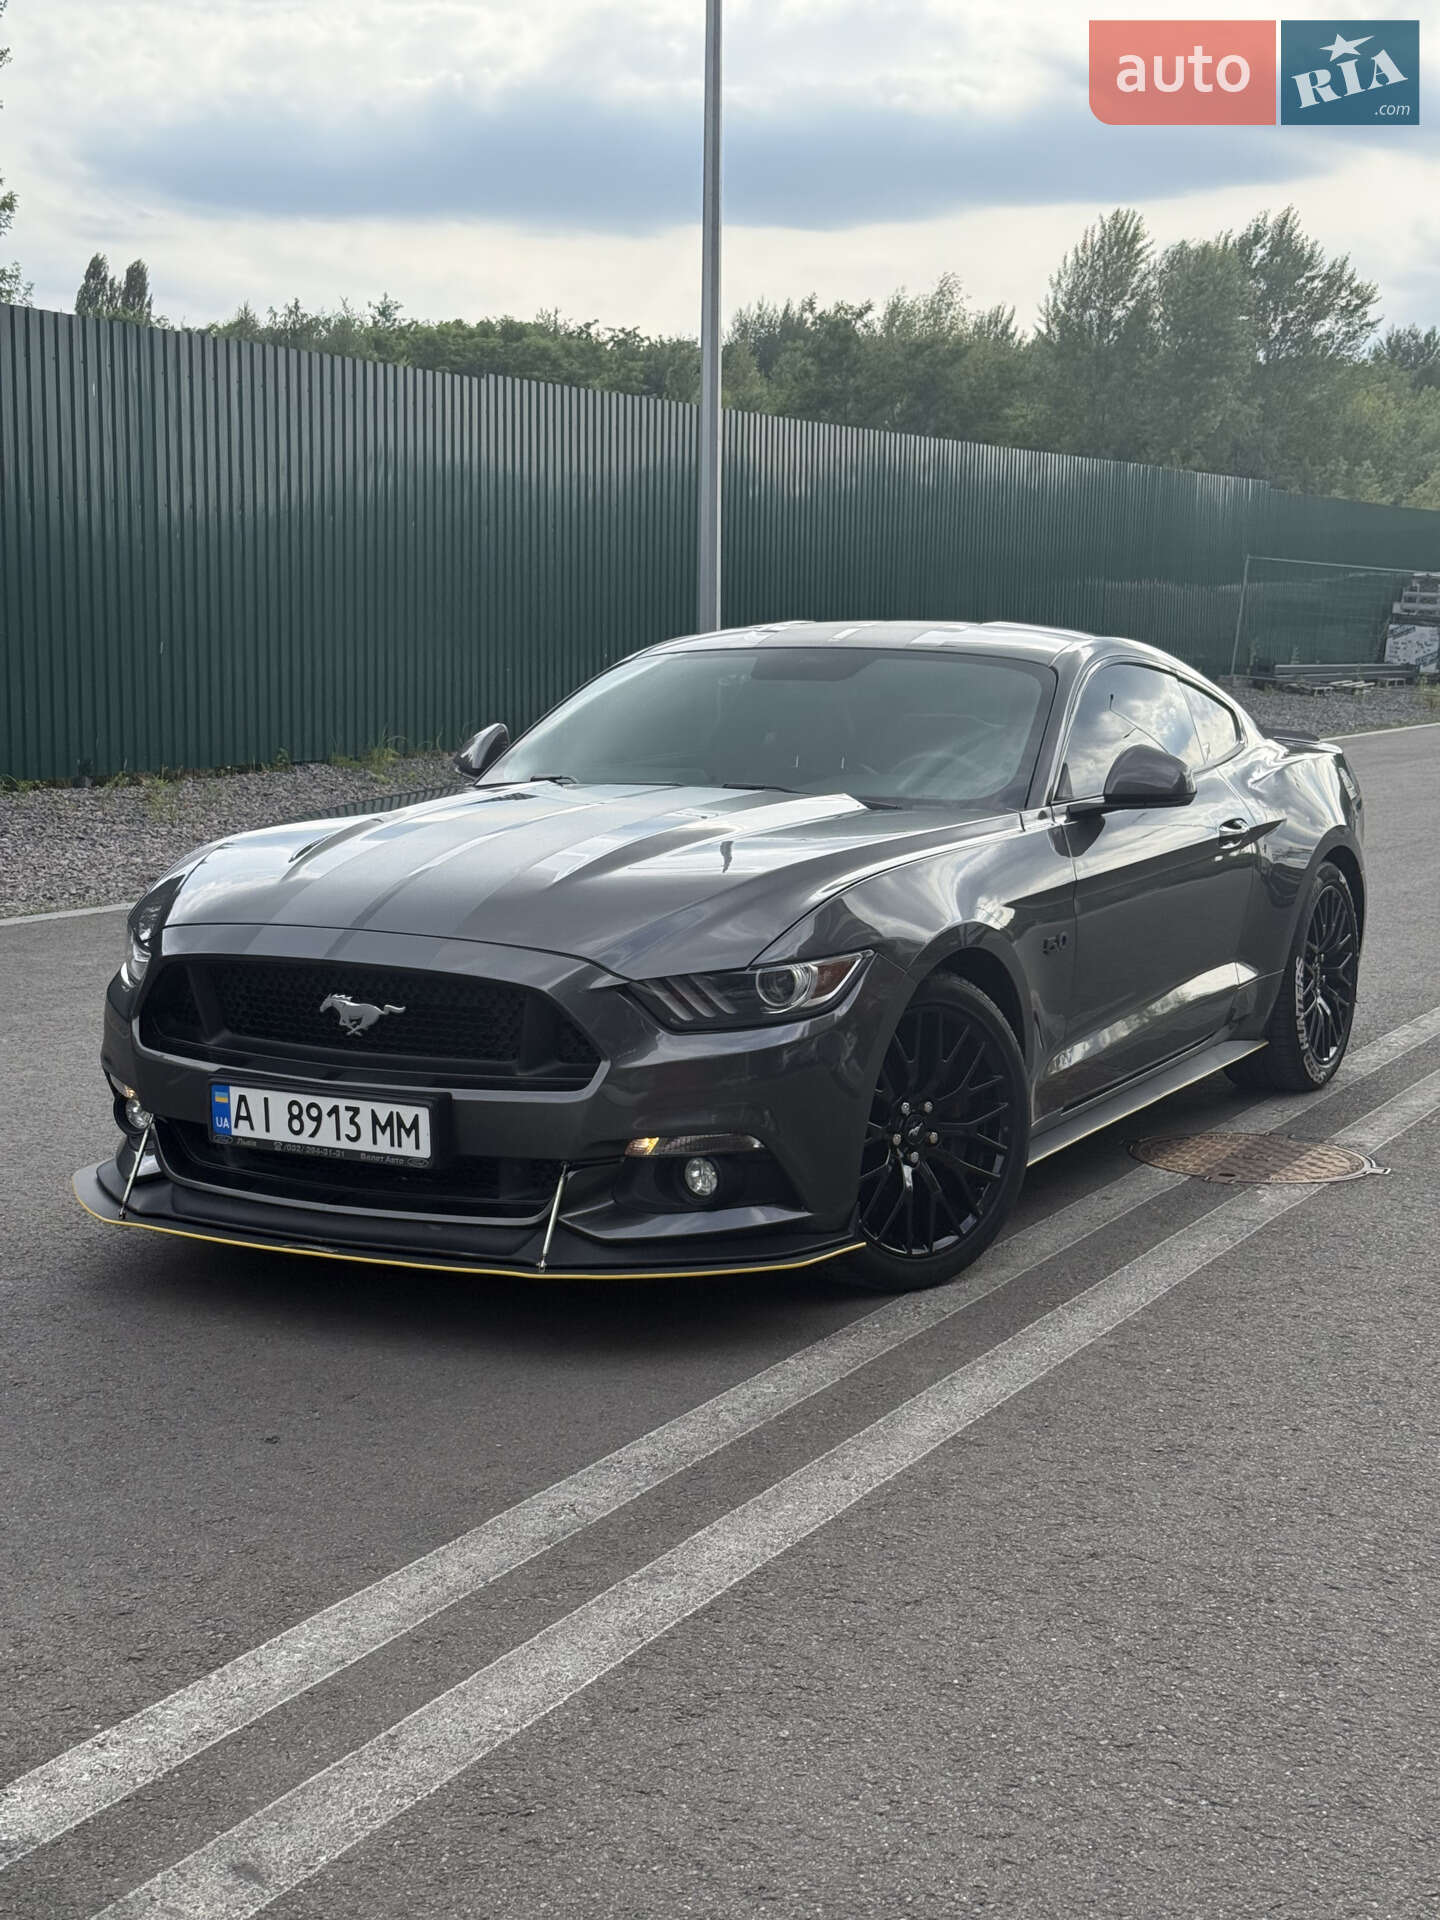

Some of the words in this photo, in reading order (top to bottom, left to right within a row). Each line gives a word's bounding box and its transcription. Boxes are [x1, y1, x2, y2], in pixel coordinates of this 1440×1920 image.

[1295, 955, 1309, 1050] HUNTERS
[215, 1116, 230, 1129] UA
[233, 1094, 271, 1133] AI
[287, 1099, 362, 1143] 8913
[370, 1108, 420, 1151] MM
